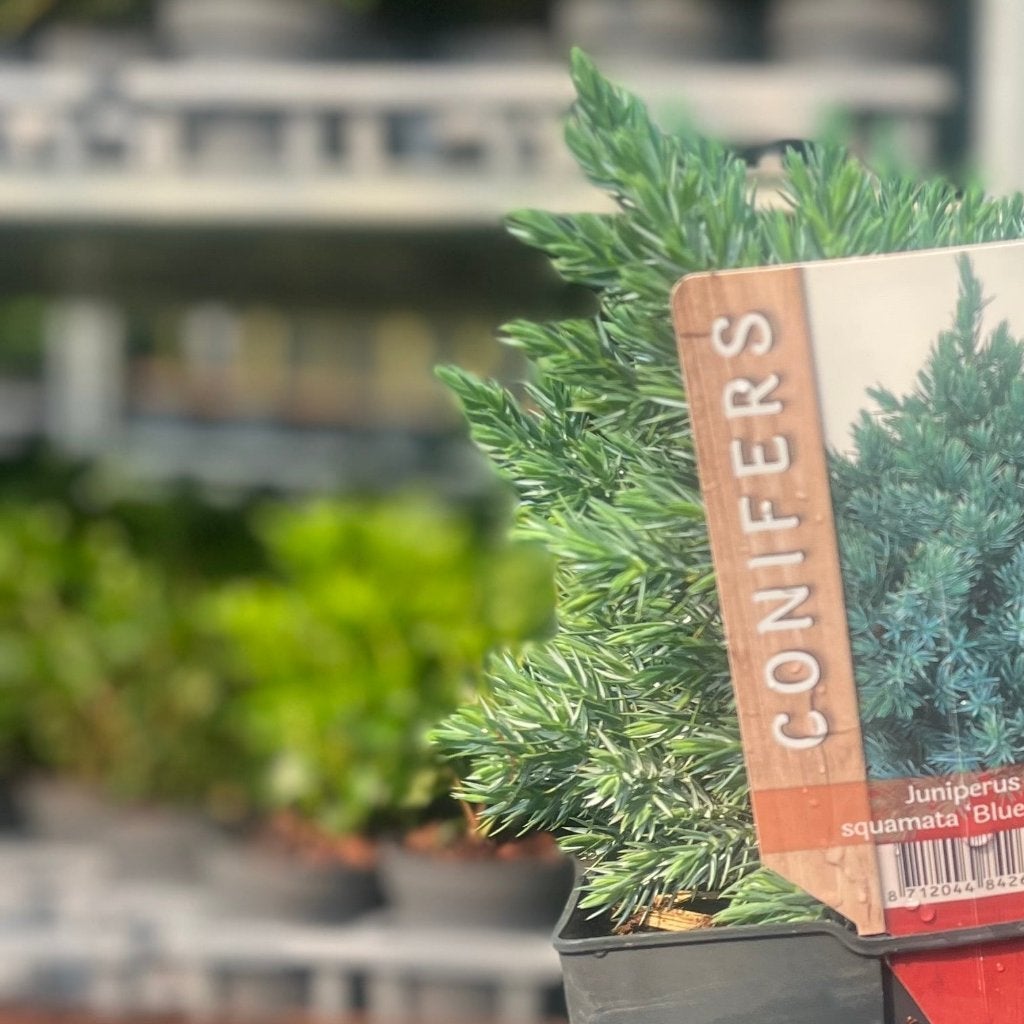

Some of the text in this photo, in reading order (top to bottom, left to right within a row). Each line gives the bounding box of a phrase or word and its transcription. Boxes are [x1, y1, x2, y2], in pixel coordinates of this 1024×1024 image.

[711, 308, 829, 752] CONIFERS
[904, 775, 1021, 805] Juniperus
[840, 812, 960, 841] squamata
